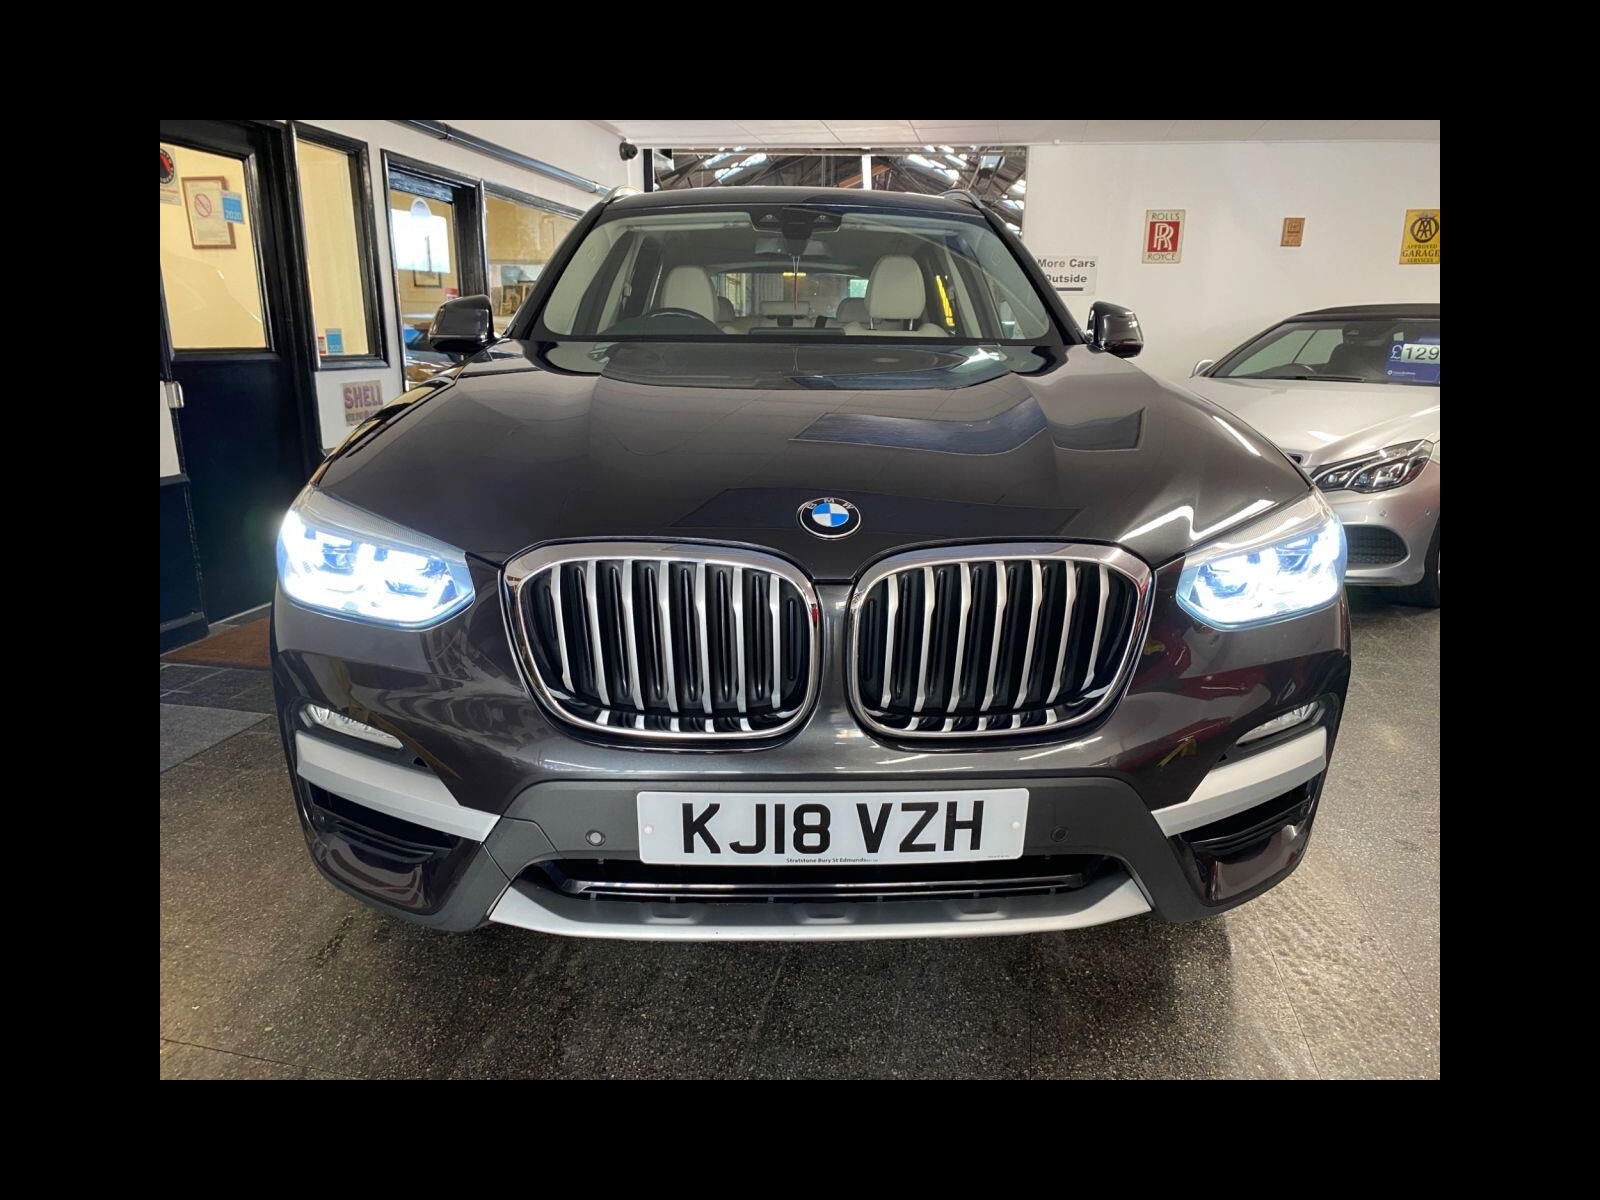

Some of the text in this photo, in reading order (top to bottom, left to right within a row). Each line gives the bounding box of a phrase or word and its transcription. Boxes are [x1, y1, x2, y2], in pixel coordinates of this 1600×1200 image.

[1152, 212, 1180, 221] ROLLS
[1147, 253, 1176, 261] ROYCE
[1037, 258, 1096, 268] More Cars
[343, 384, 383, 409] SHELL
[682, 800, 984, 855] KJ18 VZH
